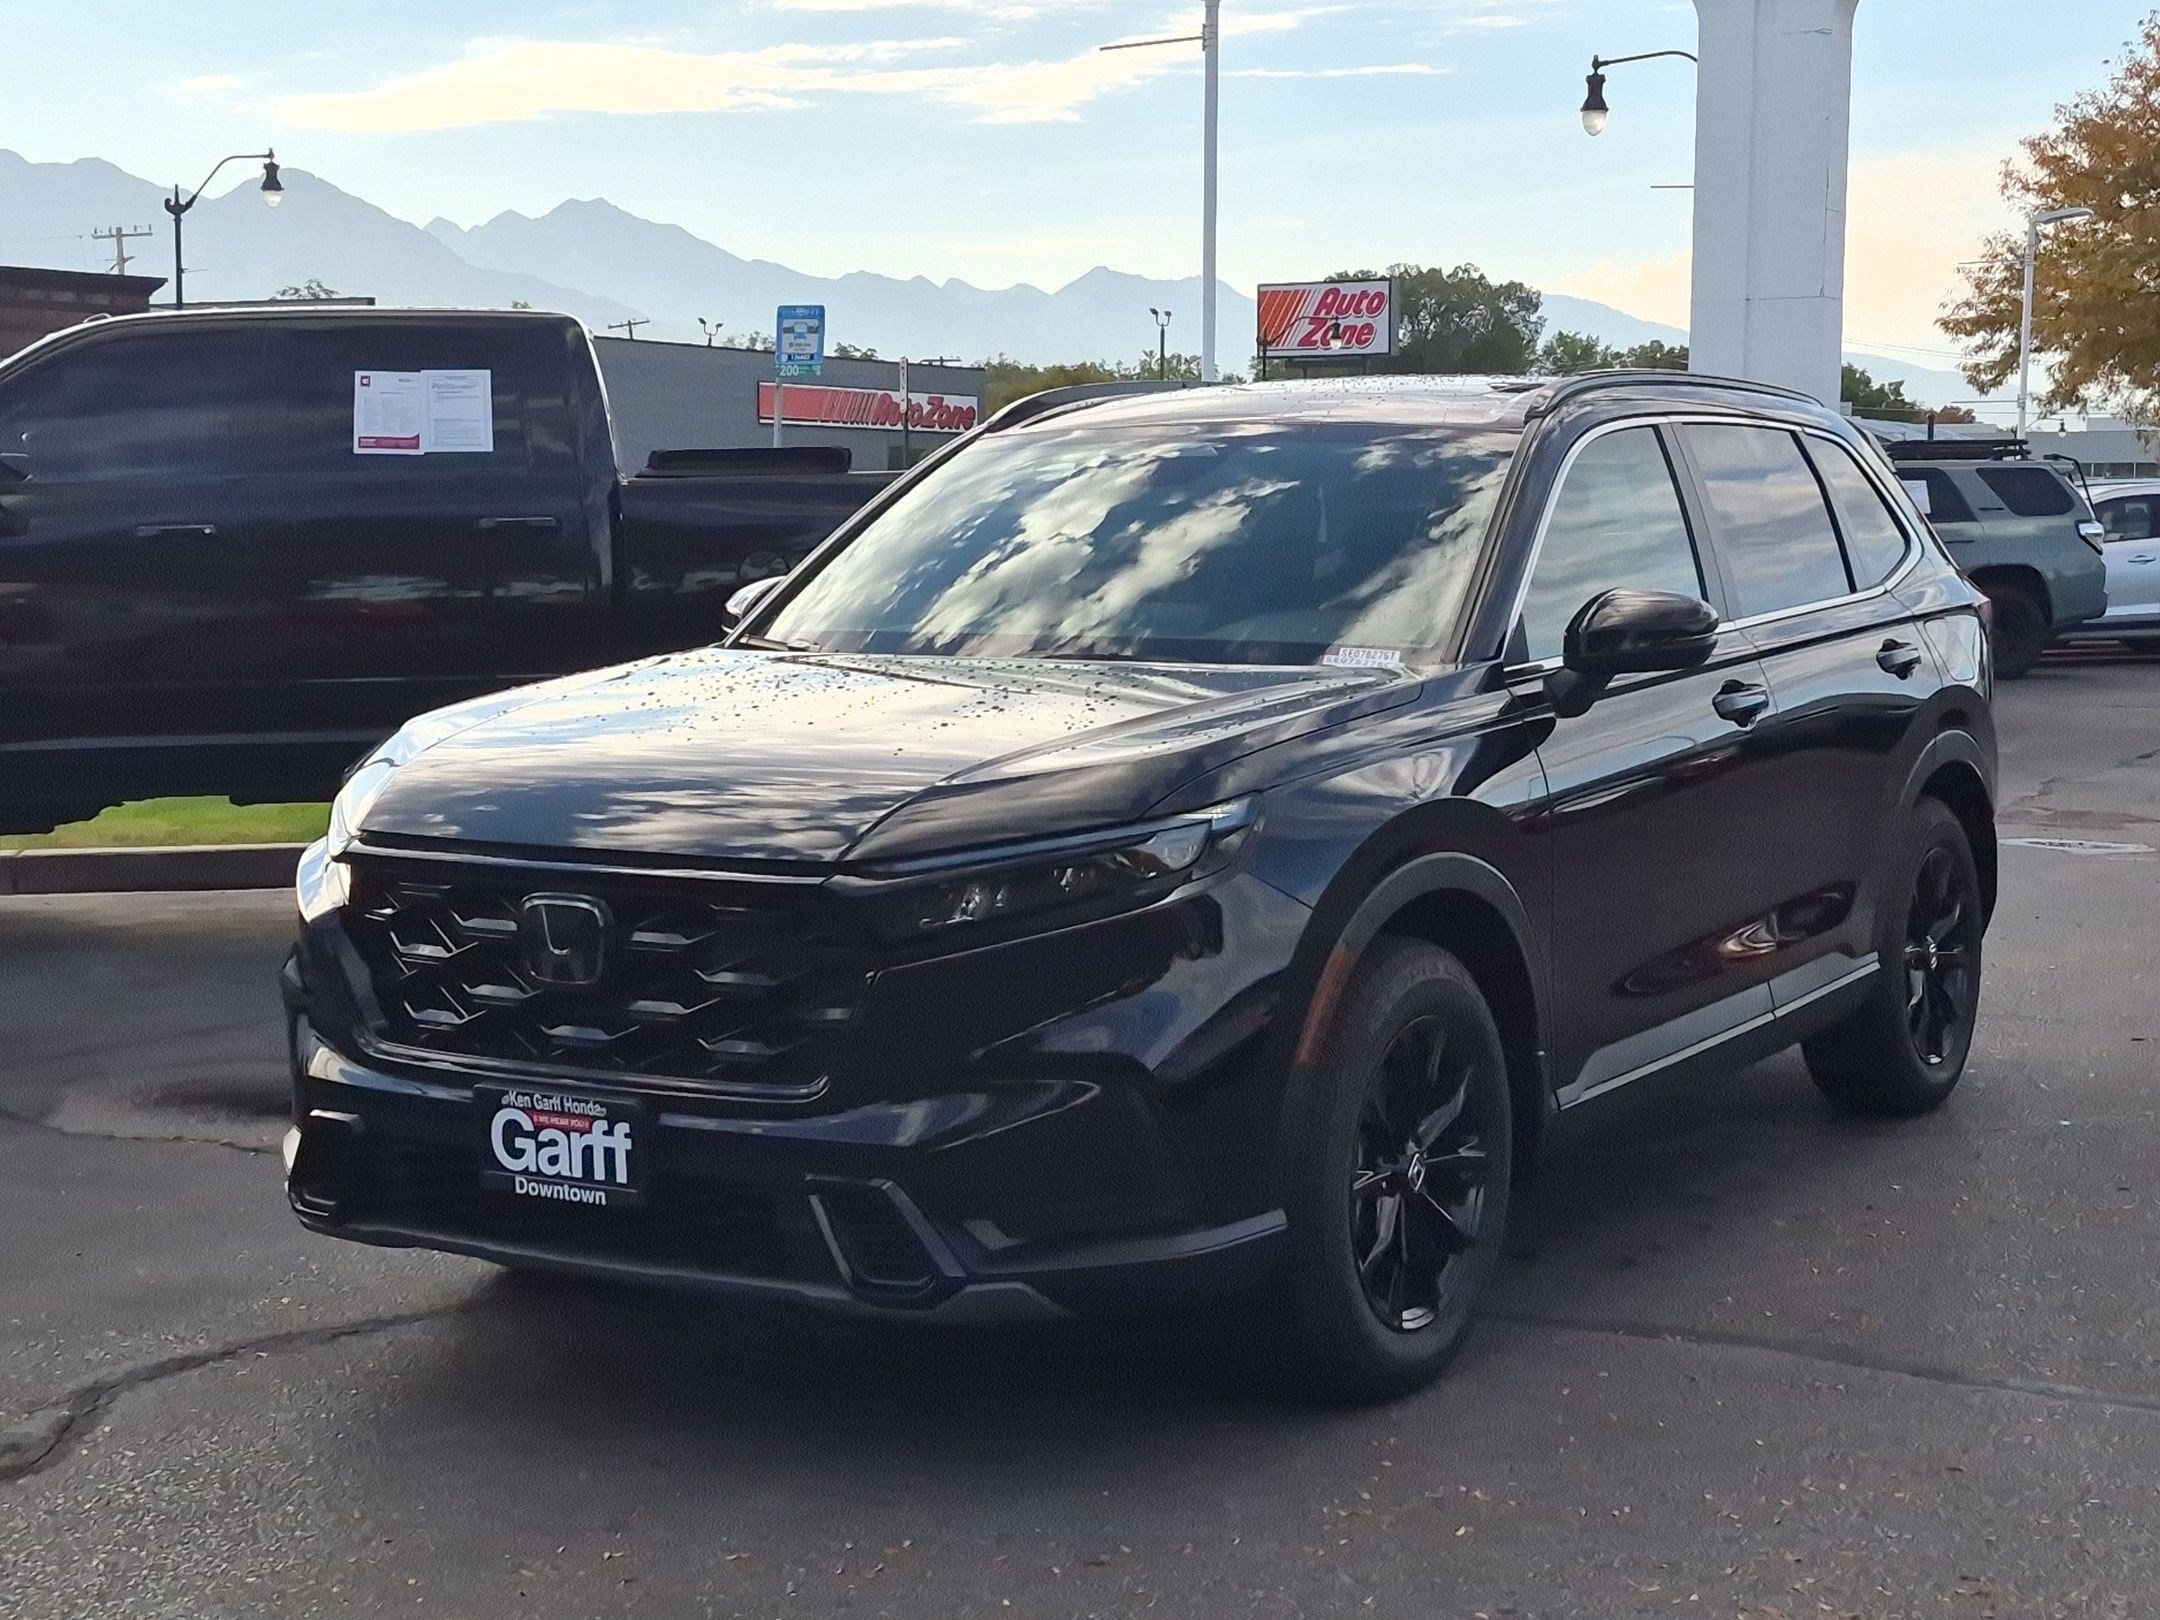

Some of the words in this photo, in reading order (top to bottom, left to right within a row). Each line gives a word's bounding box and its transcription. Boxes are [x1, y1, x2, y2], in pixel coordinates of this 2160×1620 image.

[1313, 287, 1388, 318] Auto
[509, 1090, 532, 1109] Ken
[533, 1093, 561, 1112] Garff
[563, 1096, 600, 1116] Honda
[490, 1106, 632, 1184] Garff
[514, 1176, 607, 1206] Downtown
